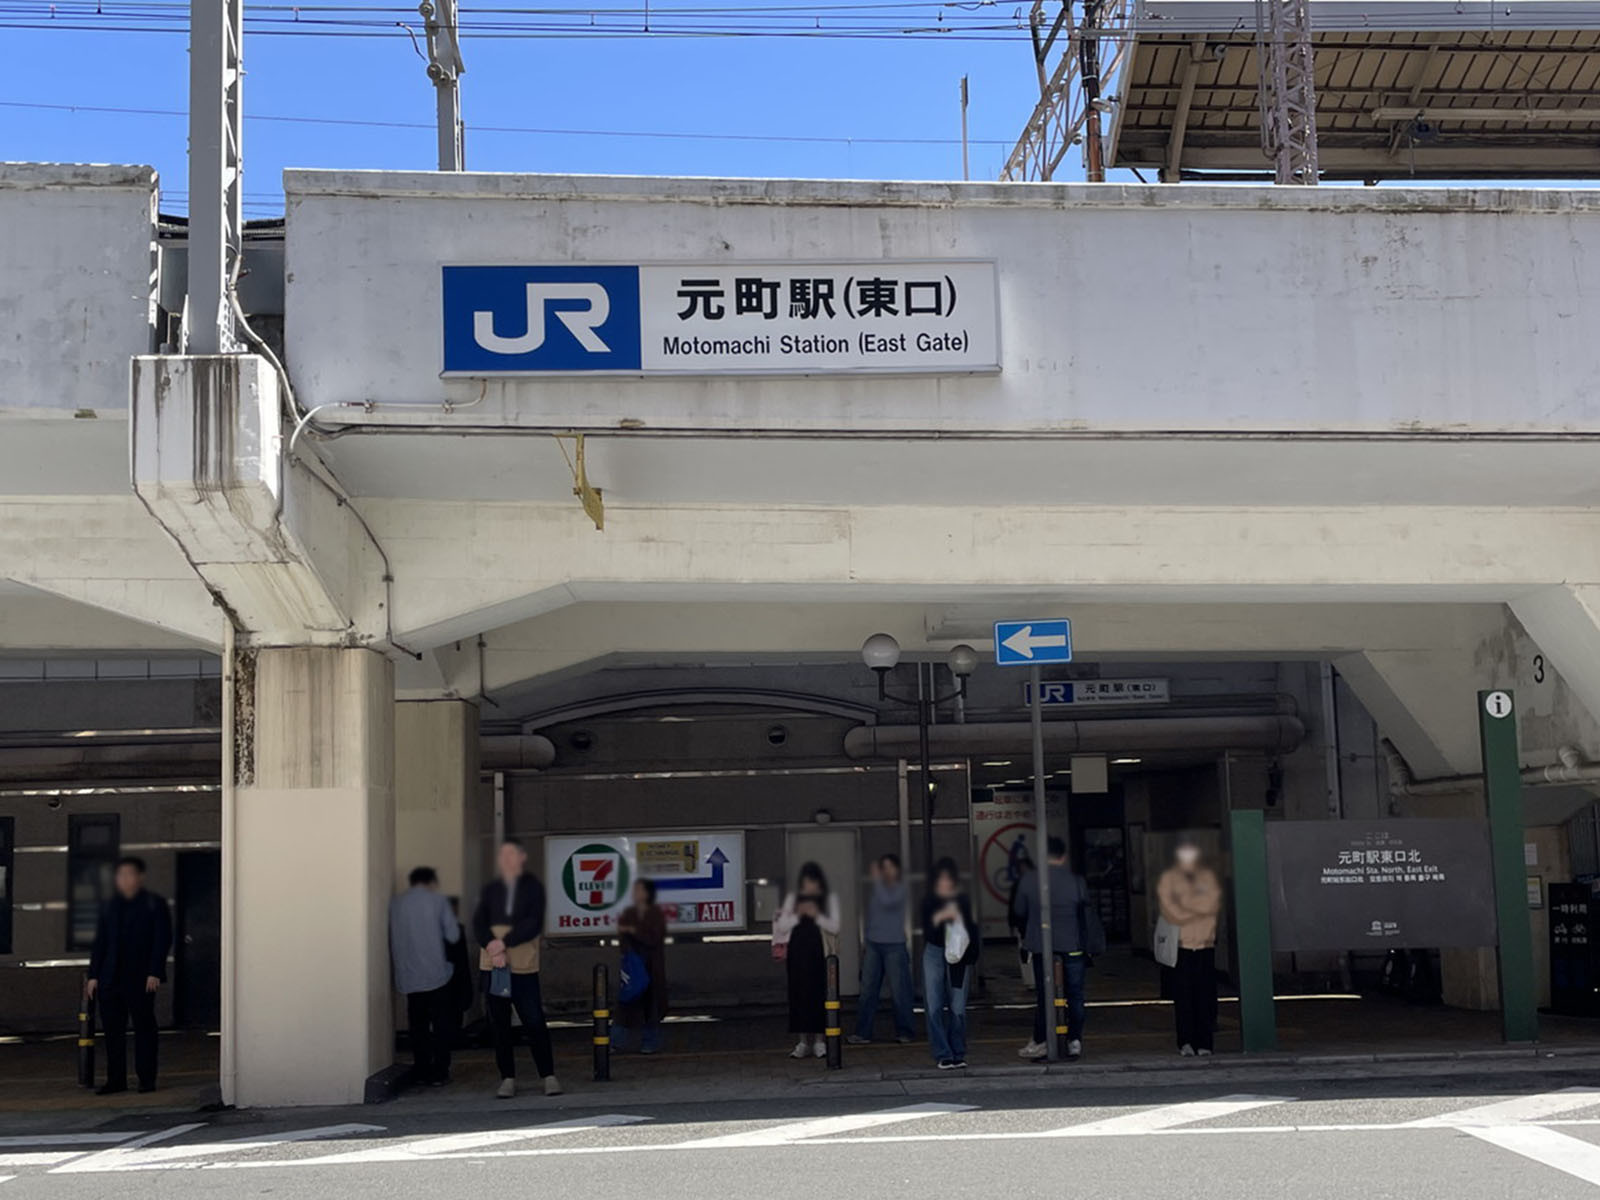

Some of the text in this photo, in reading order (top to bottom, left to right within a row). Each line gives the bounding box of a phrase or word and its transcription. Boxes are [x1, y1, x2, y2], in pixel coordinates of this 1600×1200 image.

[676, 275, 957, 320] 元町駅(東口)
[473, 282, 612, 354] JR
[663, 329, 969, 355] Motomachi Station (East Gate)
[1533, 654, 1545, 684] 3
[1039, 684, 1065, 703] JR
[1338, 850, 1421, 864] 元町駅東口北
[701, 903, 731, 922] ATM
